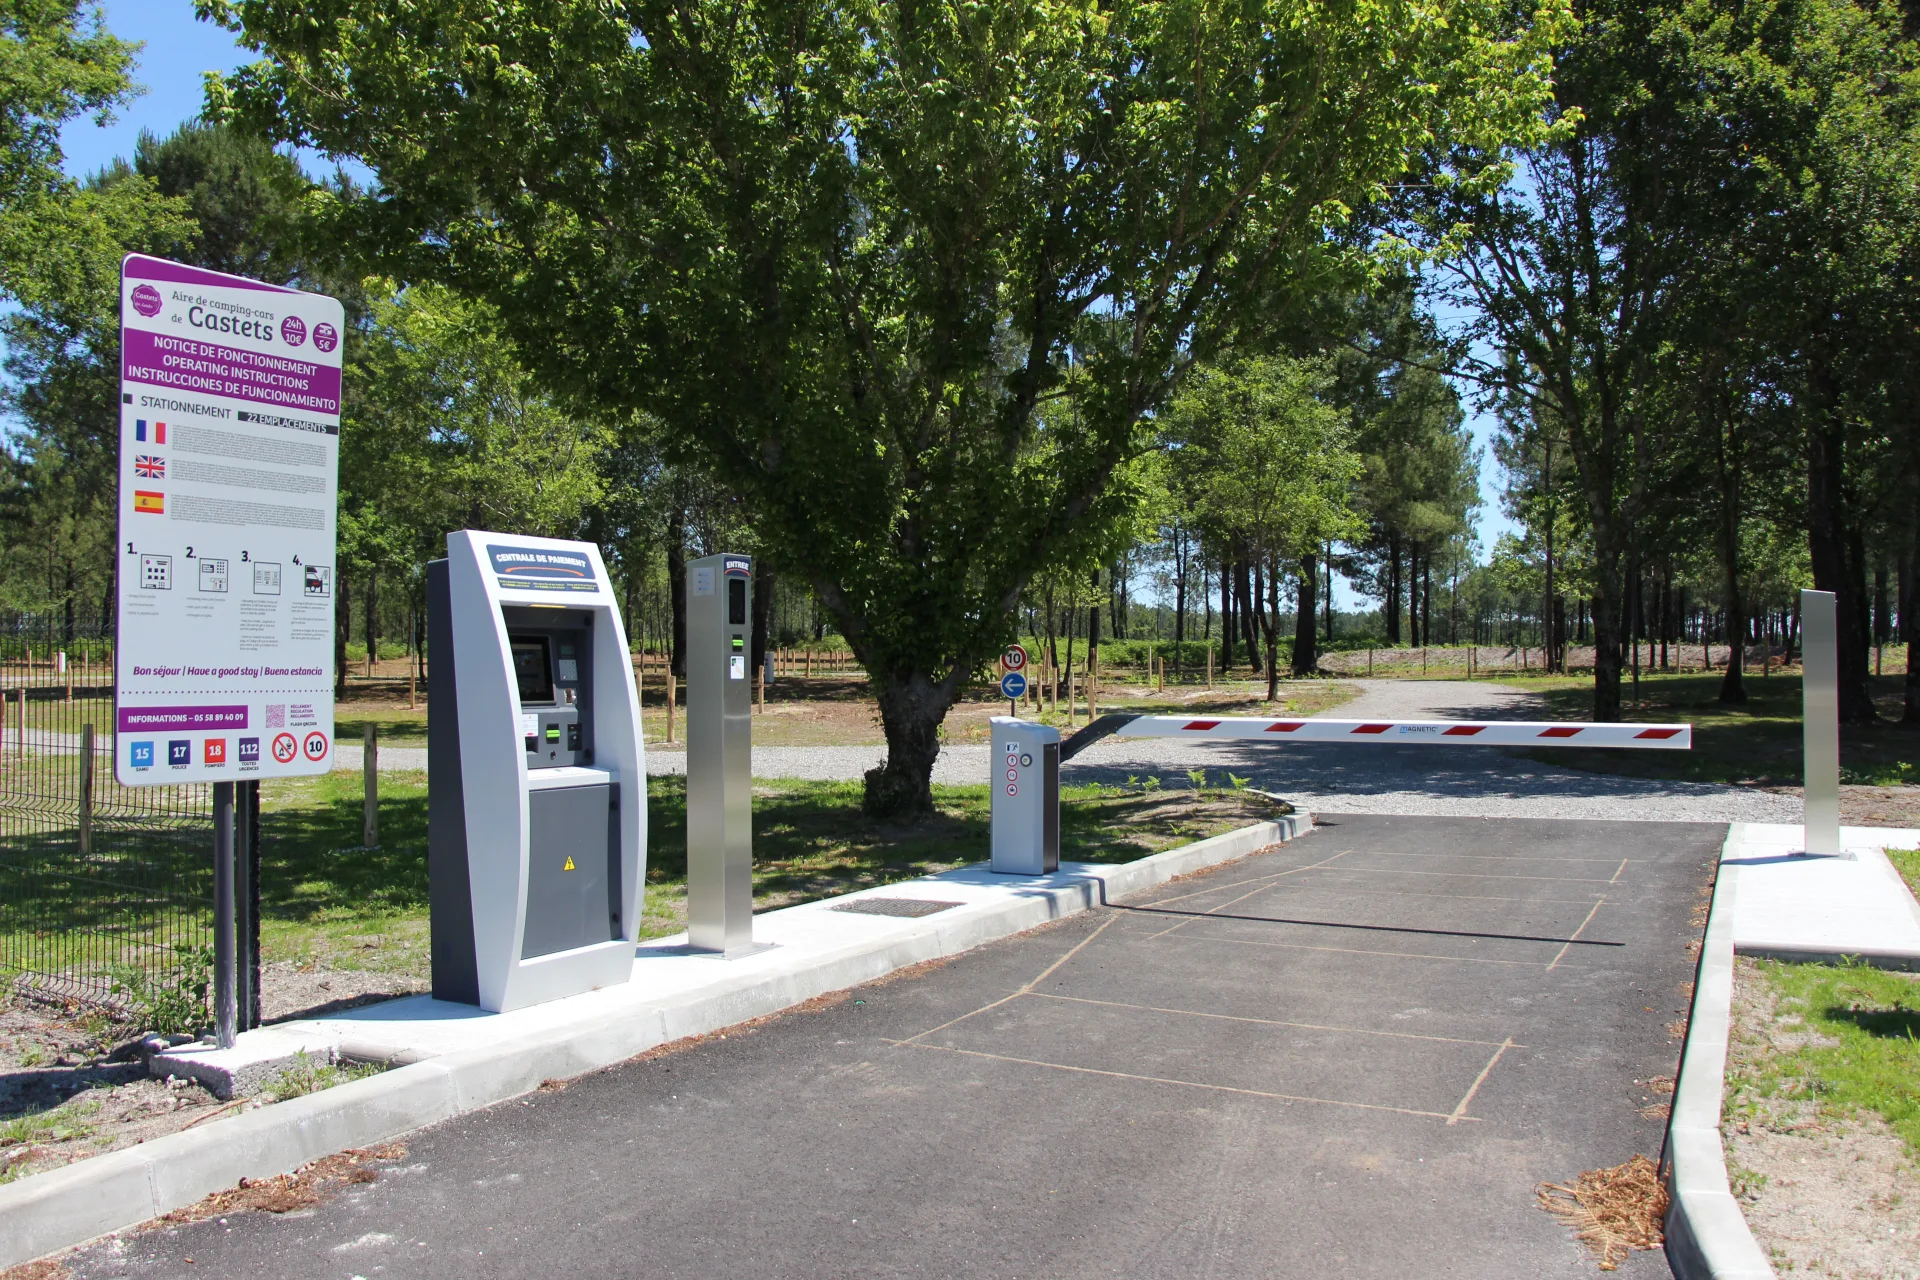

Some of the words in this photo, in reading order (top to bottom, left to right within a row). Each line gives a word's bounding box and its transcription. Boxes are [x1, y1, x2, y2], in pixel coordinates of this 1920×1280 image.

[136, 292, 158, 302] Castets
[172, 290, 194, 303] Aire
[196, 296, 208, 306] de
[210, 299, 274, 321] camping-cars
[172, 314, 182, 324] de
[188, 306, 274, 341] Castets
[286, 318, 302, 330] 24h
[286, 333, 302, 345] 10€
[318, 340, 330, 350] 5€
[154, 336, 198, 355] NOTICE
[200, 345, 216, 358] DE
[218, 348, 317, 376] FONCTIONNEMENT
[163, 354, 228, 377] OPERATING
[231, 367, 309, 391] INSTRUCTIONS
[128, 366, 222, 392] INSTRUCCIONES
[225, 382, 240, 394] DE
[242, 386, 336, 410] FUNCIONAMIENTO
[141, 396, 232, 420] STATIONNEMENT
[247, 413, 259, 423] 22
[260, 414, 327, 434] EMPLACEMENTS
[127, 542, 138, 554] 1.
[186, 546, 197, 558] 2.
[241, 550, 252, 562] 3.
[292, 554, 302, 566] 4.
[496, 554, 536, 562] CENTRALE
[536, 554, 548, 563] DE
[548, 555, 586, 568] PAIEMENT
[1007, 653, 1021, 664] 10
[133, 666, 151, 676] Bon
[153, 665, 181, 678] séjour
[187, 667, 210, 676] Have
[218, 667, 239, 678] good
[240, 667, 259, 678] stay
[264, 667, 290, 676] Buena
[290, 667, 323, 676] estancia
[128, 714, 187, 724] INFORMATIONS
[194, 714, 204, 722] 05
[204, 714, 214, 722] 58
[174, 746, 187, 758] 17
[208, 745, 222, 756] 18
[240, 744, 258, 755] 112
[310, 740, 322, 752] 10
[136, 748, 149, 760] 15
